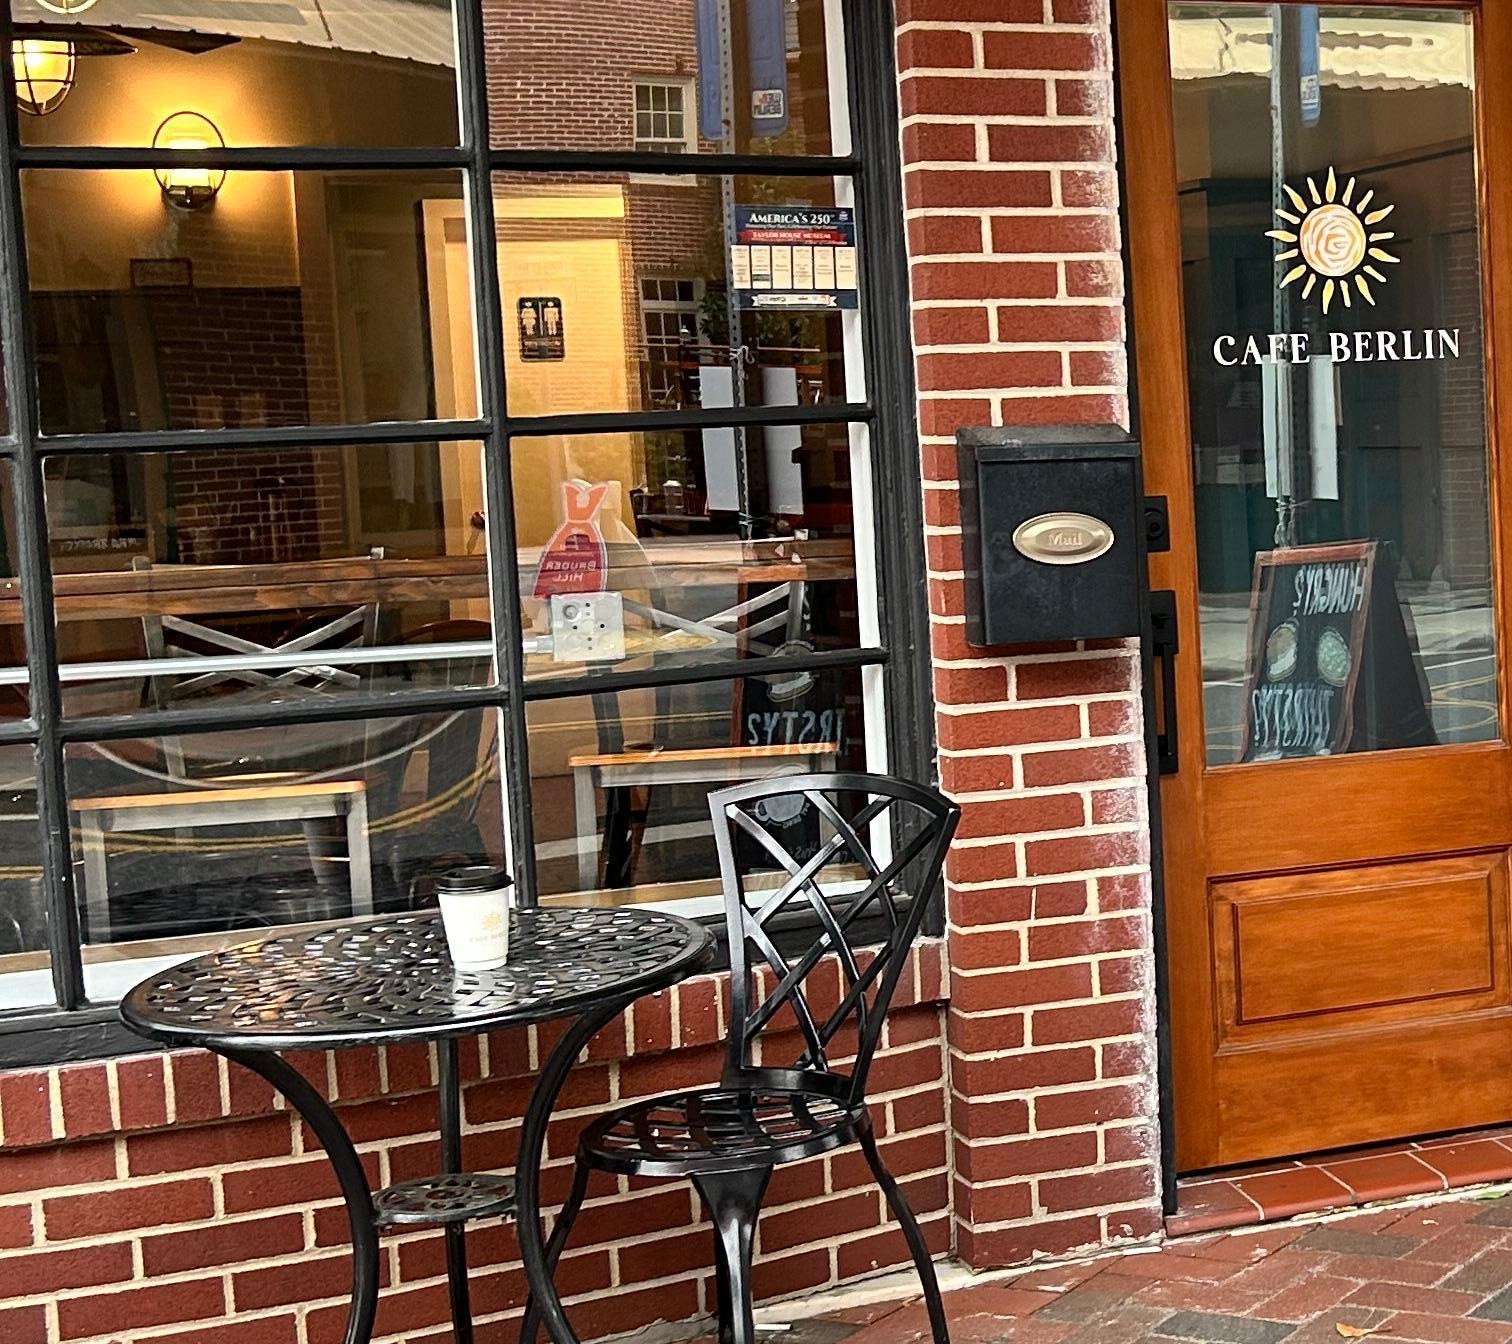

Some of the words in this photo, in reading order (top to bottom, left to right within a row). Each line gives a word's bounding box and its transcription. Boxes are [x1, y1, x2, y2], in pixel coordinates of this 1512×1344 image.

[749, 213, 808, 224] AMERICA'S
[1213, 333, 1310, 366] CAFE
[1329, 328, 1460, 363] BERLIN
